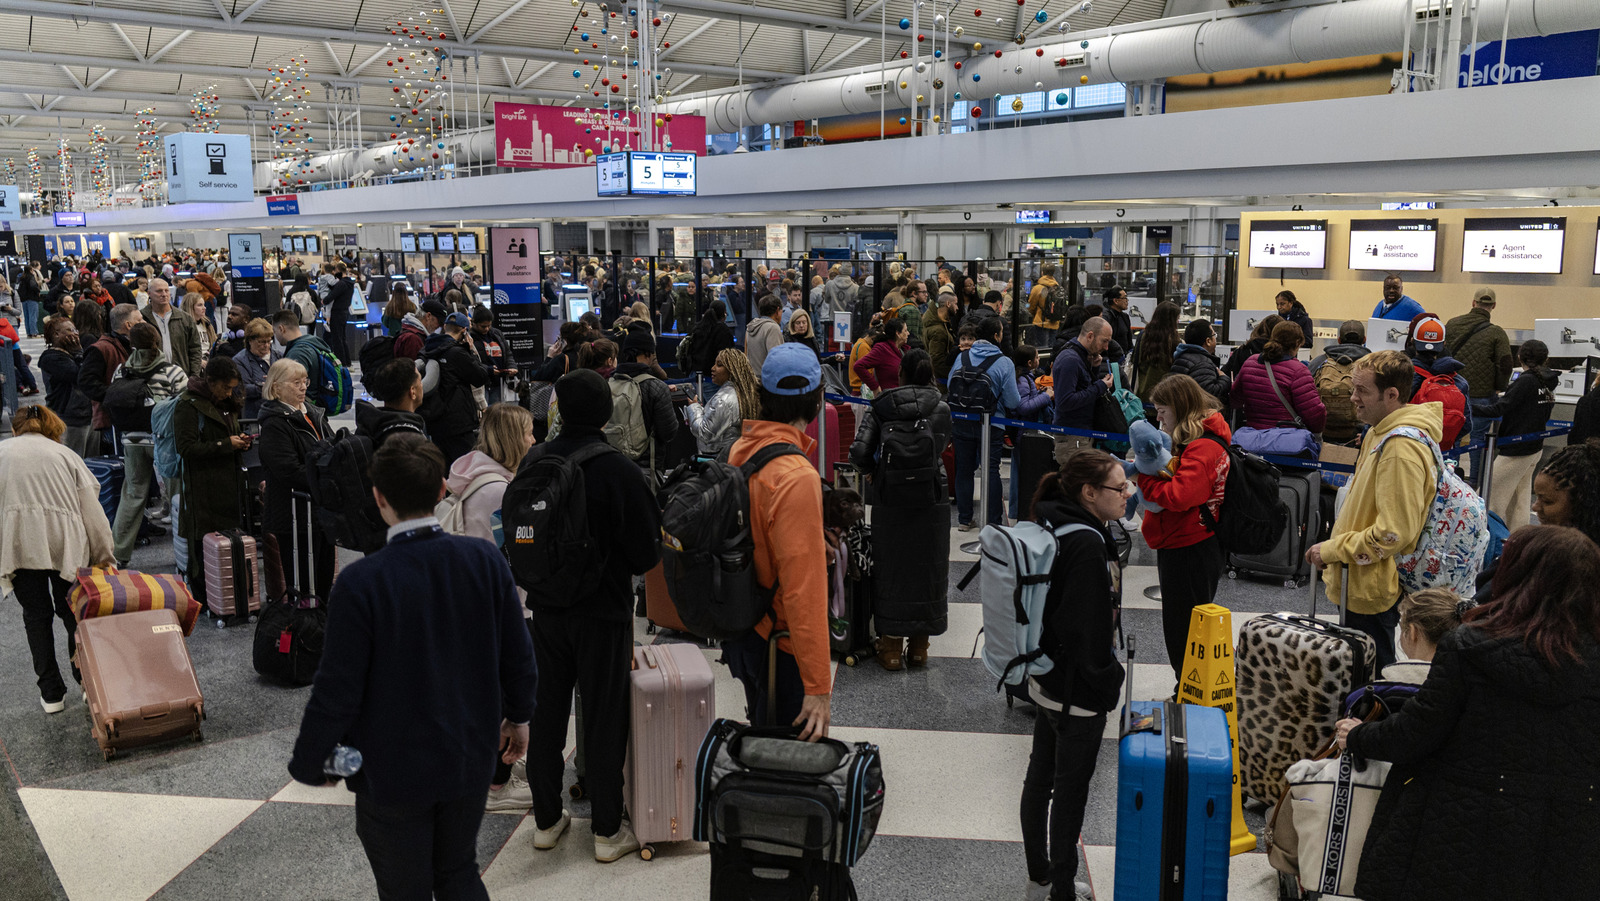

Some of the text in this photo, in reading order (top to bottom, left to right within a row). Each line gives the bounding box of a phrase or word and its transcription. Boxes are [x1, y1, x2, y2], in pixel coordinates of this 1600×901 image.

[591, 124, 615, 132] CANR
[603, 168, 607, 181] 5
[644, 166, 652, 179] 5
[63, 241, 76, 250] UNITED
[89, 240, 103, 251] UNITED
[1383, 243, 1404, 251] Agent
[1502, 244, 1526, 253] Agent
[1279, 249, 1311, 257] assistance
[1383, 250, 1418, 258] assistance
[1501, 252, 1543, 260] assistance
[516, 525, 534, 539] BOLD
[1183, 682, 1203, 700] CAUTION
[1212, 687, 1233, 701] CAUTION
[1334, 788, 1348, 825] KORS
[1327, 832, 1341, 869] KORS
[1323, 875, 1335, 894] RS
